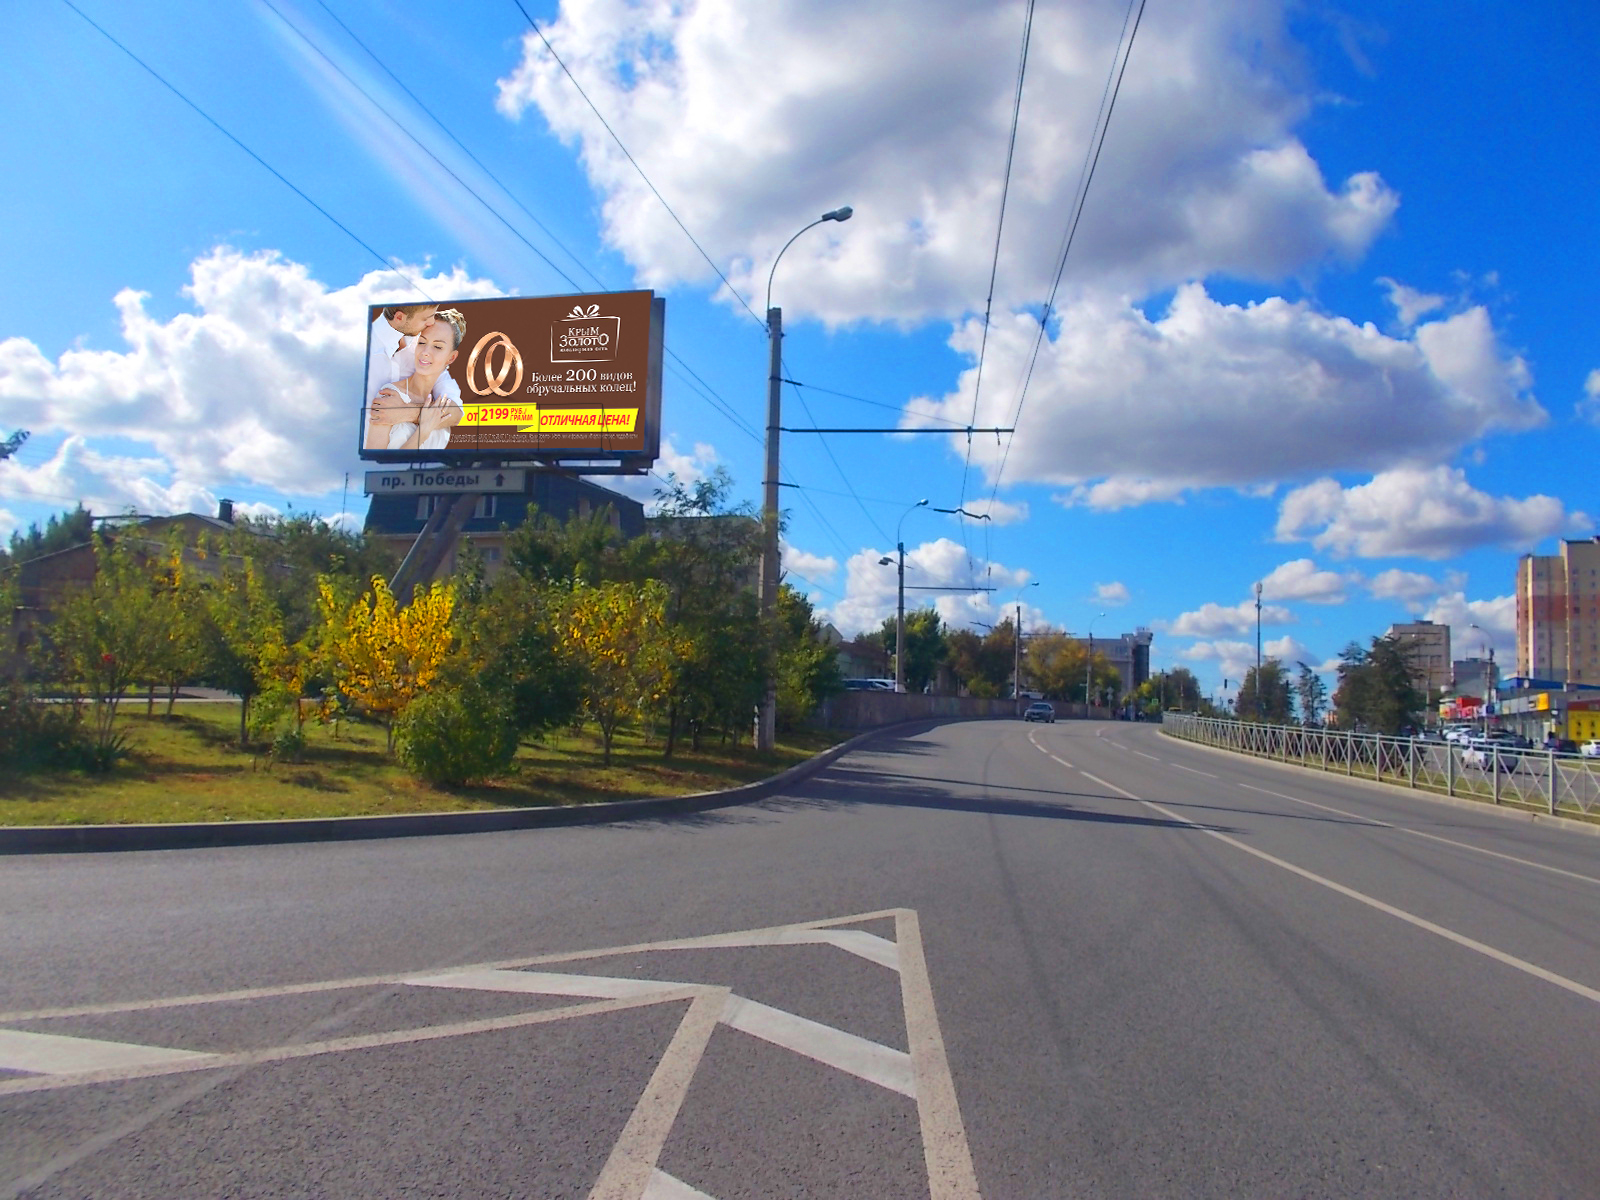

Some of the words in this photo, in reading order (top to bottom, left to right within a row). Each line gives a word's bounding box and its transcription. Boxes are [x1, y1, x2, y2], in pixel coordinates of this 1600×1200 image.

[532, 372, 563, 382] Более
[566, 369, 597, 382] 200
[600, 371, 633, 382] видов
[526, 383, 597, 396] обручальных
[600, 381, 637, 393] колец!
[466, 412, 479, 422] ОТ
[480, 408, 509, 422] 2199
[540, 414, 596, 426] ОТЛИЧНАЯ
[597, 414, 630, 427] ЦЕНА!
[381, 476, 405, 490] пр.
[412, 473, 480, 488] Победы
